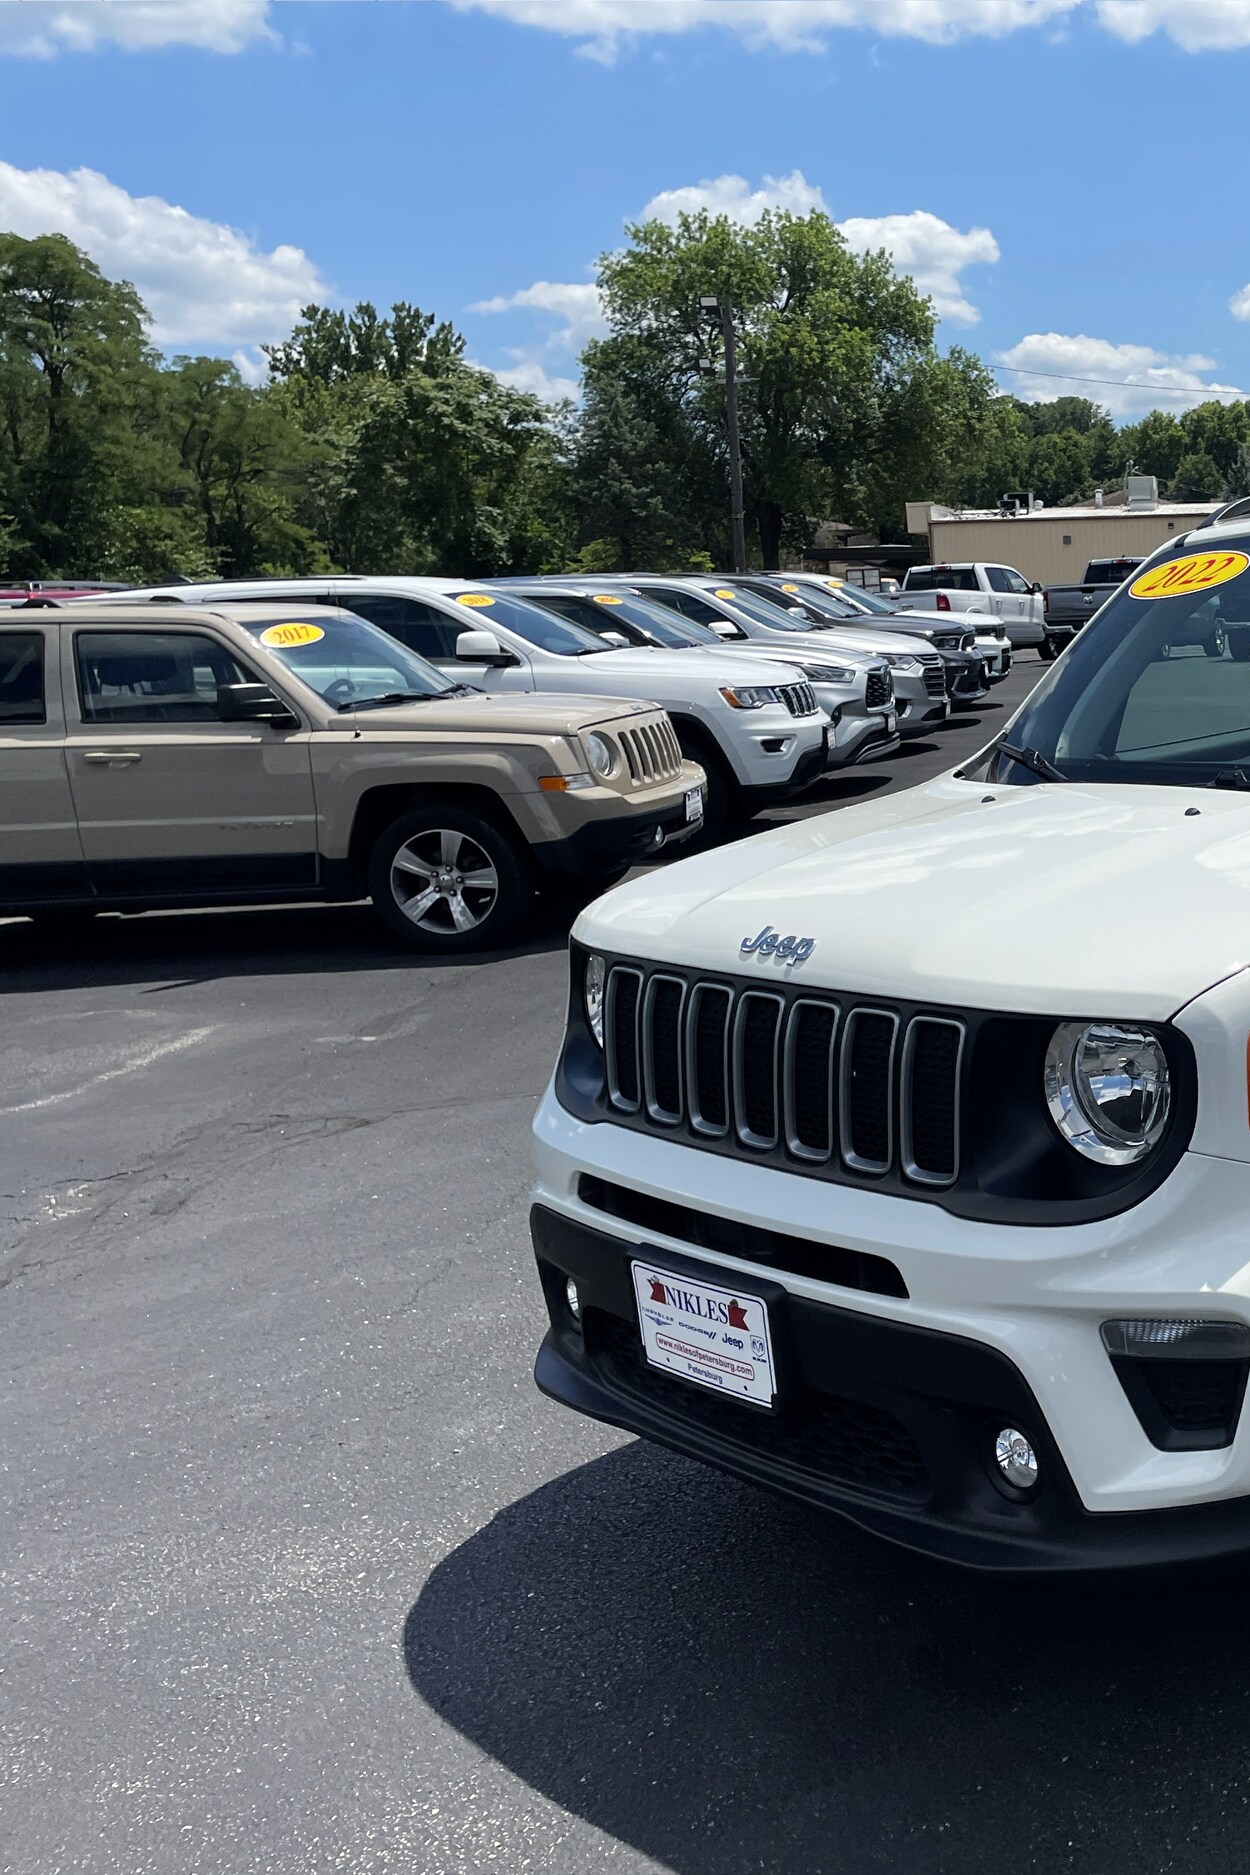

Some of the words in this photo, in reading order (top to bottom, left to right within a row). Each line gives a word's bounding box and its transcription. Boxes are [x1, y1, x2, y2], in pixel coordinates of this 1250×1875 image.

[1141, 557, 1235, 592] 2022
[272, 625, 310, 645] 2017
[740, 925, 816, 967] Jeep
[665, 1286, 728, 1324] NIKLES
[642, 1306, 674, 1321] CHRYSLER
[721, 1333, 744, 1350] Jeep
[658, 1336, 753, 1376] www.niklesofpetersburg.com
[687, 1363, 723, 1384] Petersburg
